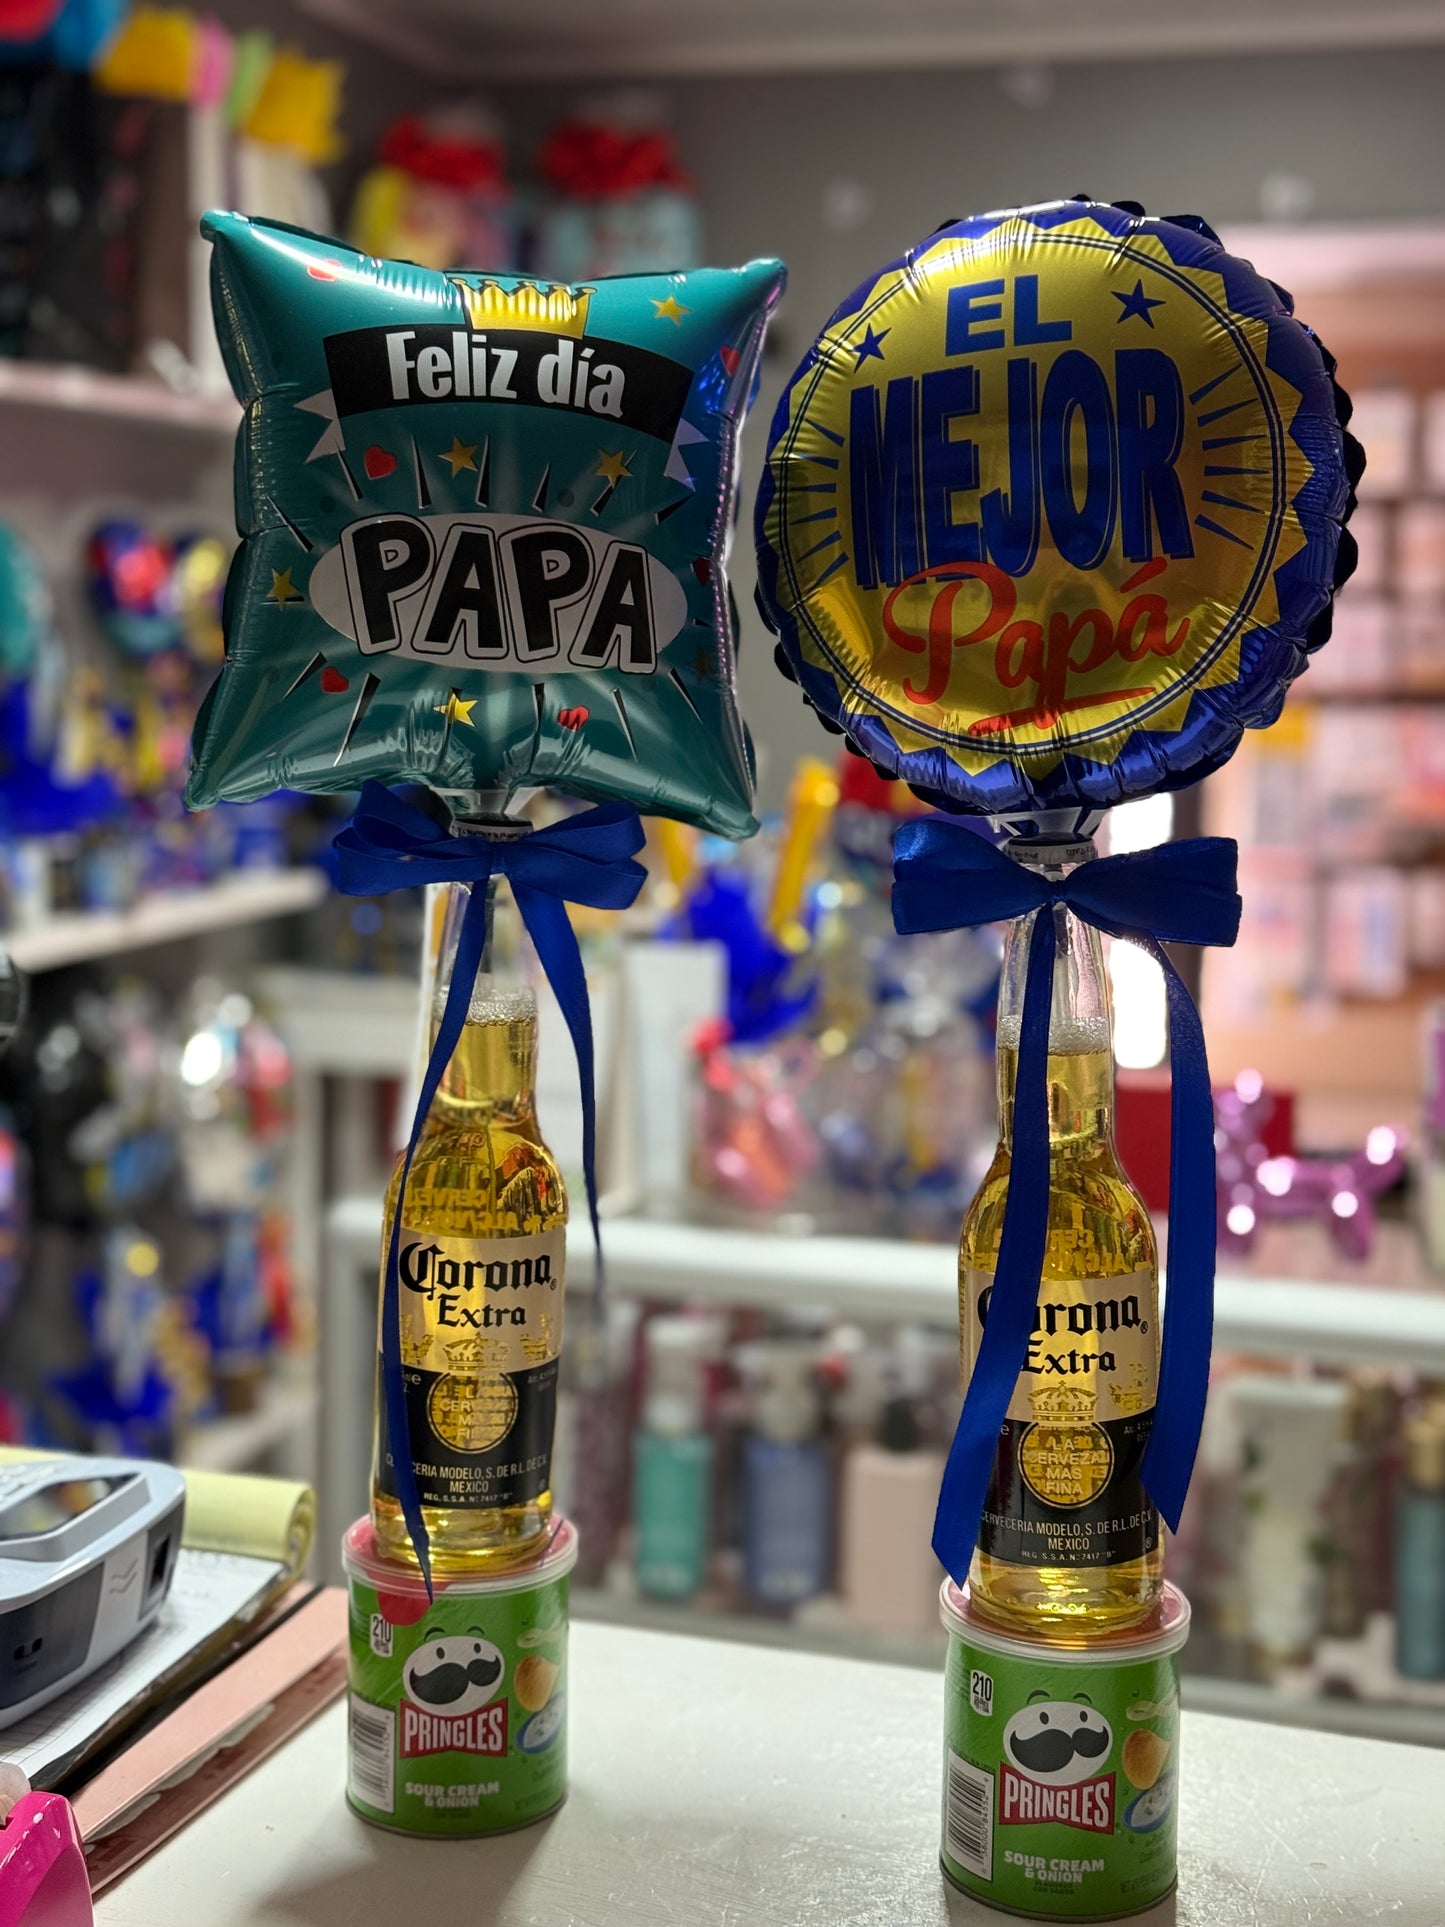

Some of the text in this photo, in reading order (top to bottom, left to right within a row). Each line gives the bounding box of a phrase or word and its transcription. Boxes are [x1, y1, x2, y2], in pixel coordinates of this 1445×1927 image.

[945, 274, 1072, 357] EL
[386, 331, 627, 418] Feliz día
[850, 349, 1195, 590] MEJOR
[341, 512, 657, 674] PAPA
[882, 556, 1191, 730] Papá
[437, 1293, 526, 1329] Extra
[1021, 1339, 1116, 1375] Extra
[1052, 1438, 1074, 1451] LA
[1028, 1452, 1099, 1465] CERVEZA
[439, 1467, 485, 1480] MODELO,
[485, 1467, 496, 1478] S.
[497, 1465, 509, 1478] DE
[1047, 1467, 1082, 1480] MAS
[449, 1481, 489, 1493] MEXICO
[1046, 1482, 1083, 1495] FINA
[1036, 1523, 1084, 1537] MODELO,
[1085, 1523, 1096, 1535] S.
[1097, 1521, 1110, 1534] DE
[1129, 1514, 1140, 1527] DE
[1047, 1537, 1090, 1550] MEXICO
[372, 1615, 392, 1643] 210
[972, 1671, 993, 1702] 210
[404, 1706, 503, 1751] PRINGLES
[405, 1781, 500, 1796] SOUR CREAM
[1004, 1772, 1110, 1828] PRINGLES
[436, 1796, 479, 1808] ONION
[1004, 1850, 1105, 1872] SOUR CREAM
[1024, 1867, 1083, 1883] & ONION
